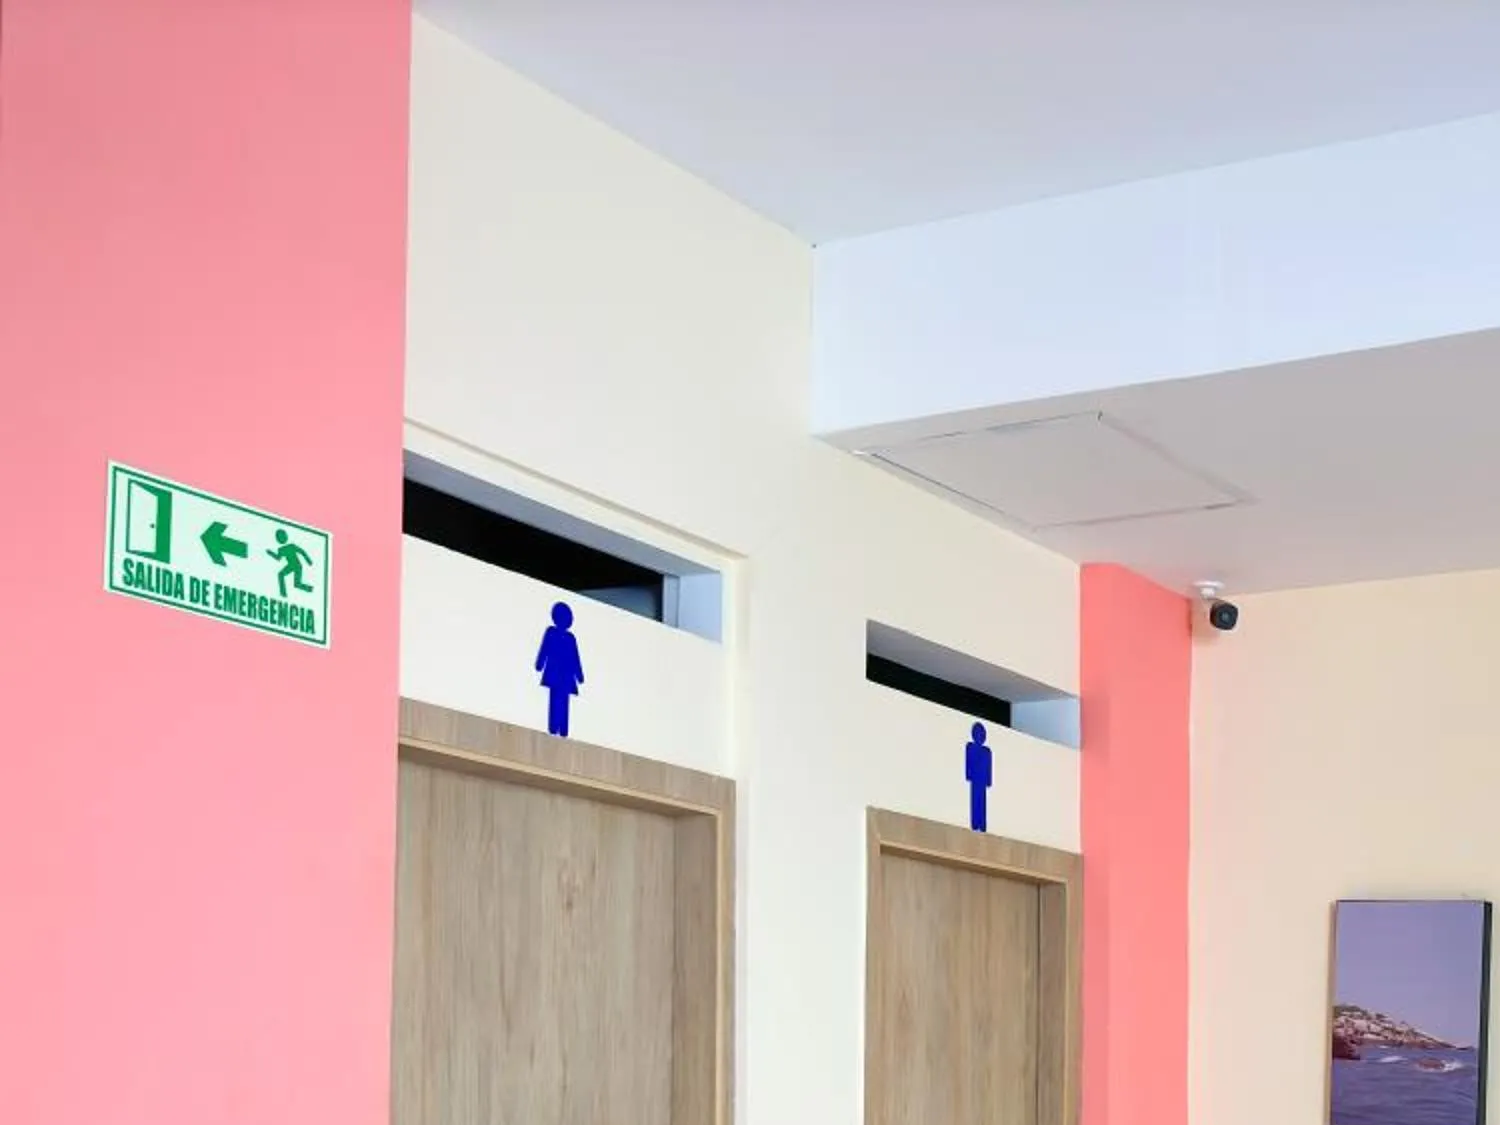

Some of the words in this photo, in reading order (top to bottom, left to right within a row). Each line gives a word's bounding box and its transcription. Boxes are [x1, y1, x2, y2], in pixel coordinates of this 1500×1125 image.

[122, 558, 185, 600] SALIDA
[189, 575, 210, 607] DE
[214, 583, 315, 634] EMERGENCIA
